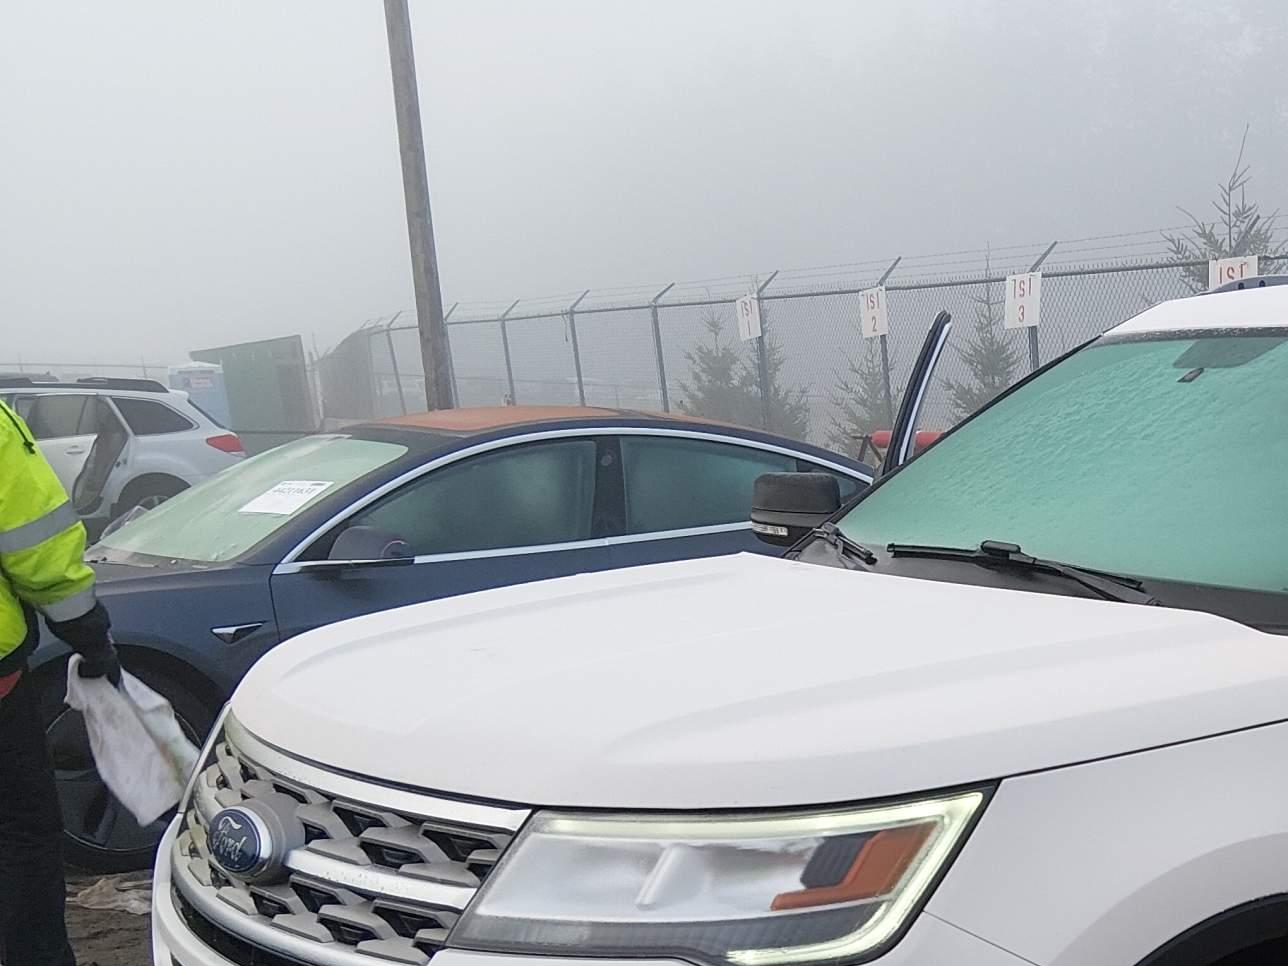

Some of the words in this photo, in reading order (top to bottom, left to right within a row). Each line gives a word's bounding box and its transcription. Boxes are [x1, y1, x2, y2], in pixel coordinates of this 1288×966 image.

[1018, 304, 1025, 323] 3
[871, 315, 878, 332] 2
[212, 816, 247, 862] Ford
